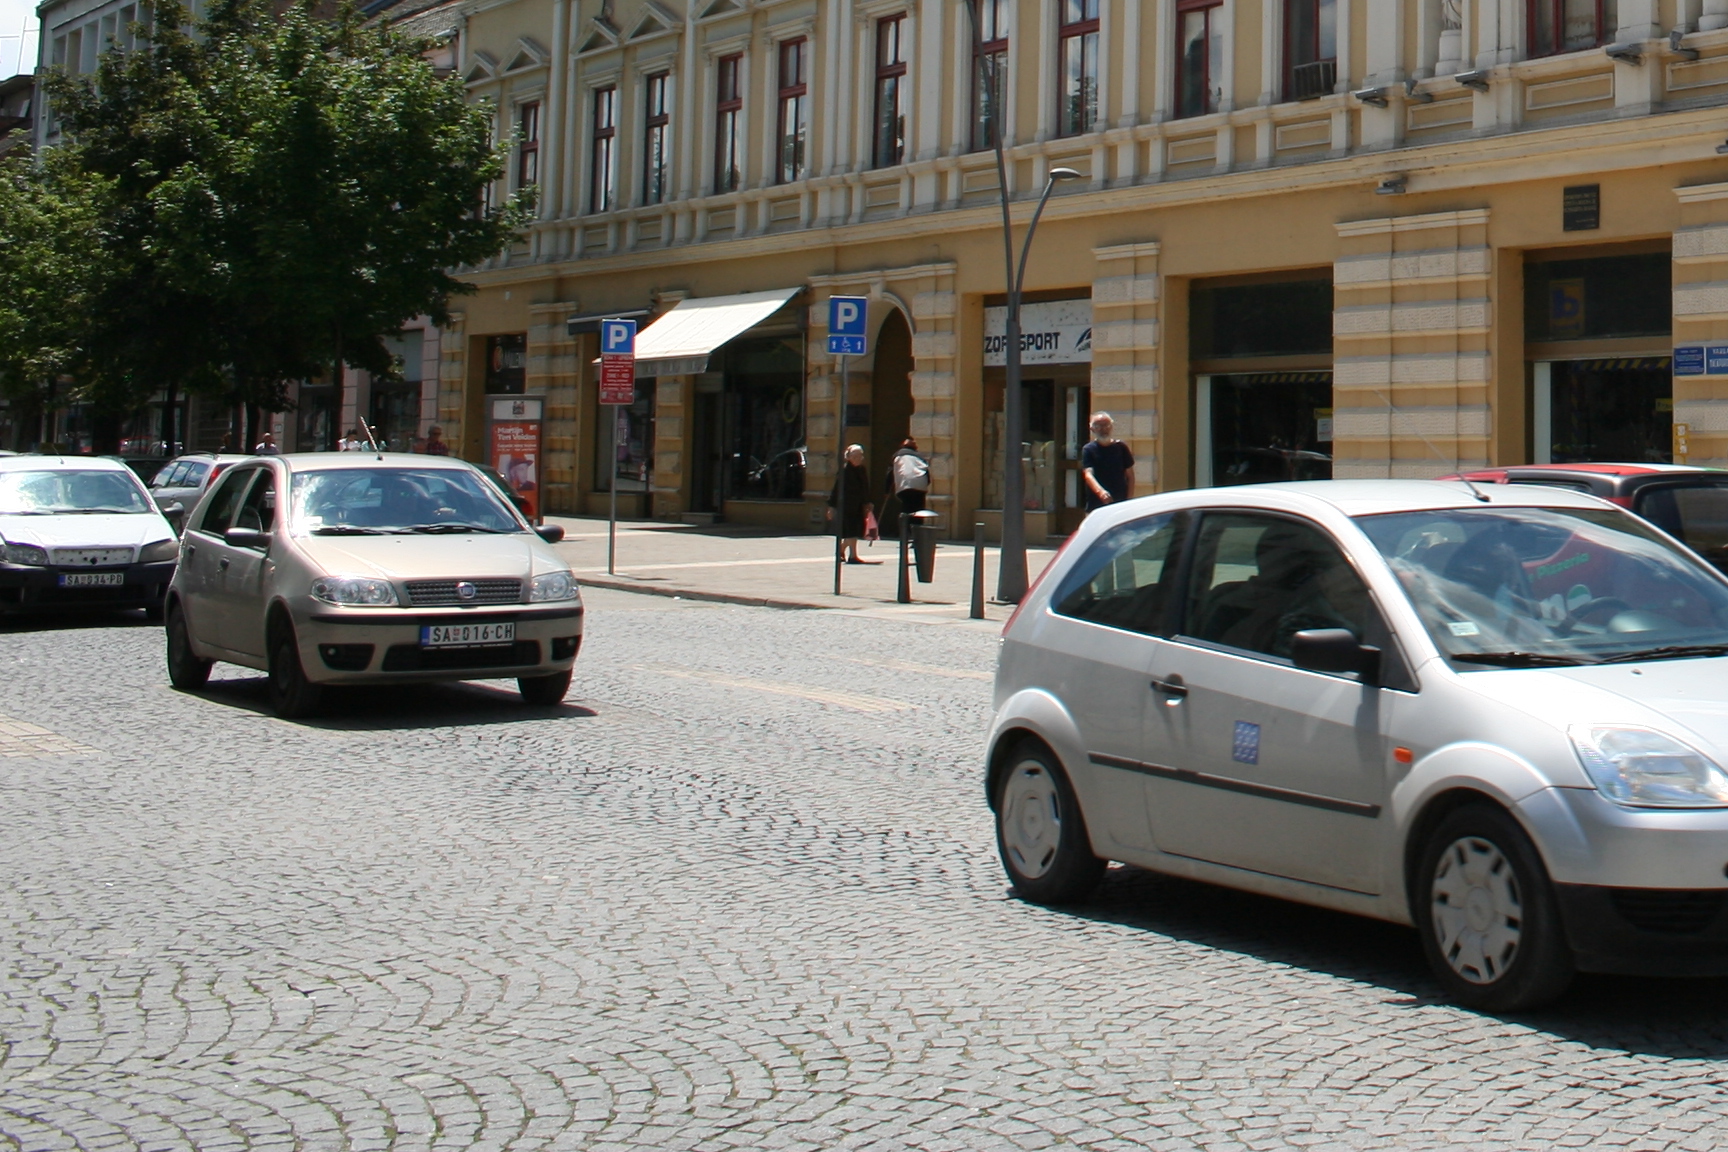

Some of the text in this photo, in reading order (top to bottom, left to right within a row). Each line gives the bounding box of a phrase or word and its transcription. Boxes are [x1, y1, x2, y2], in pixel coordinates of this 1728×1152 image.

[837, 302, 858, 330] P
[609, 325, 628, 349] P
[1019, 332, 1060, 351] SPORT
[433, 626, 452, 642] SA
